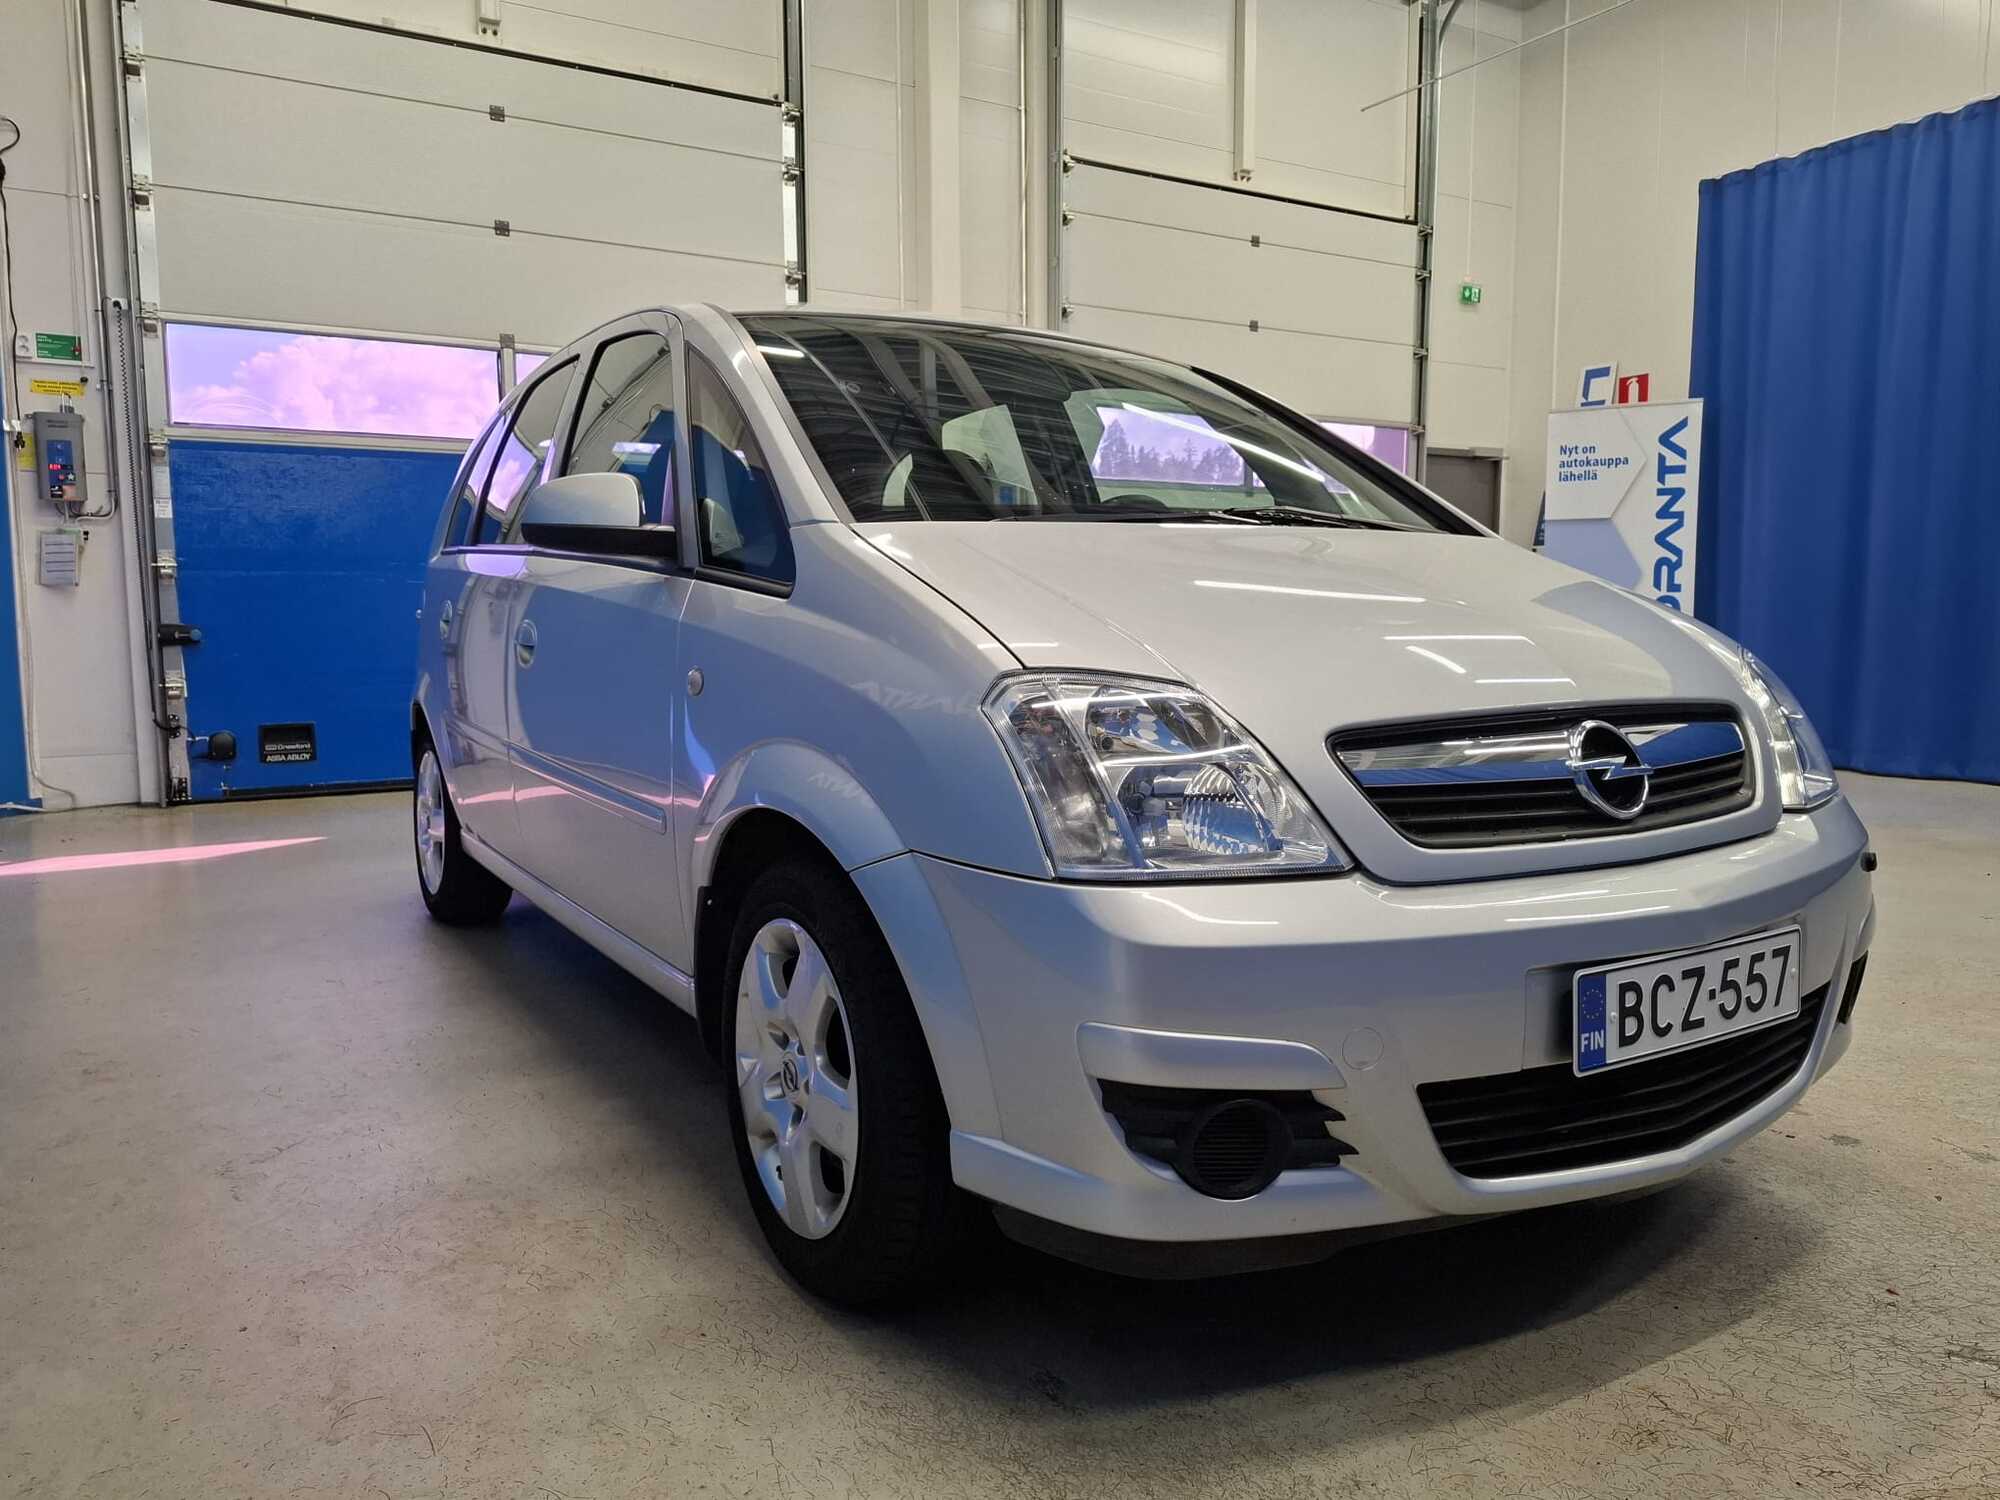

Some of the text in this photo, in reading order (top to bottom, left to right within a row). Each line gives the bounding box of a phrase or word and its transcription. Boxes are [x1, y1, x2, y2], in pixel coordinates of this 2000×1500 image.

[1560, 444, 1596, 458] Nyt on
[1559, 455, 1629, 469] autokauppa
[1558, 469, 1598, 482] lähellä
[1618, 945, 1792, 1048] BCZ-557
[1580, 1030, 1605, 1052] FIN
